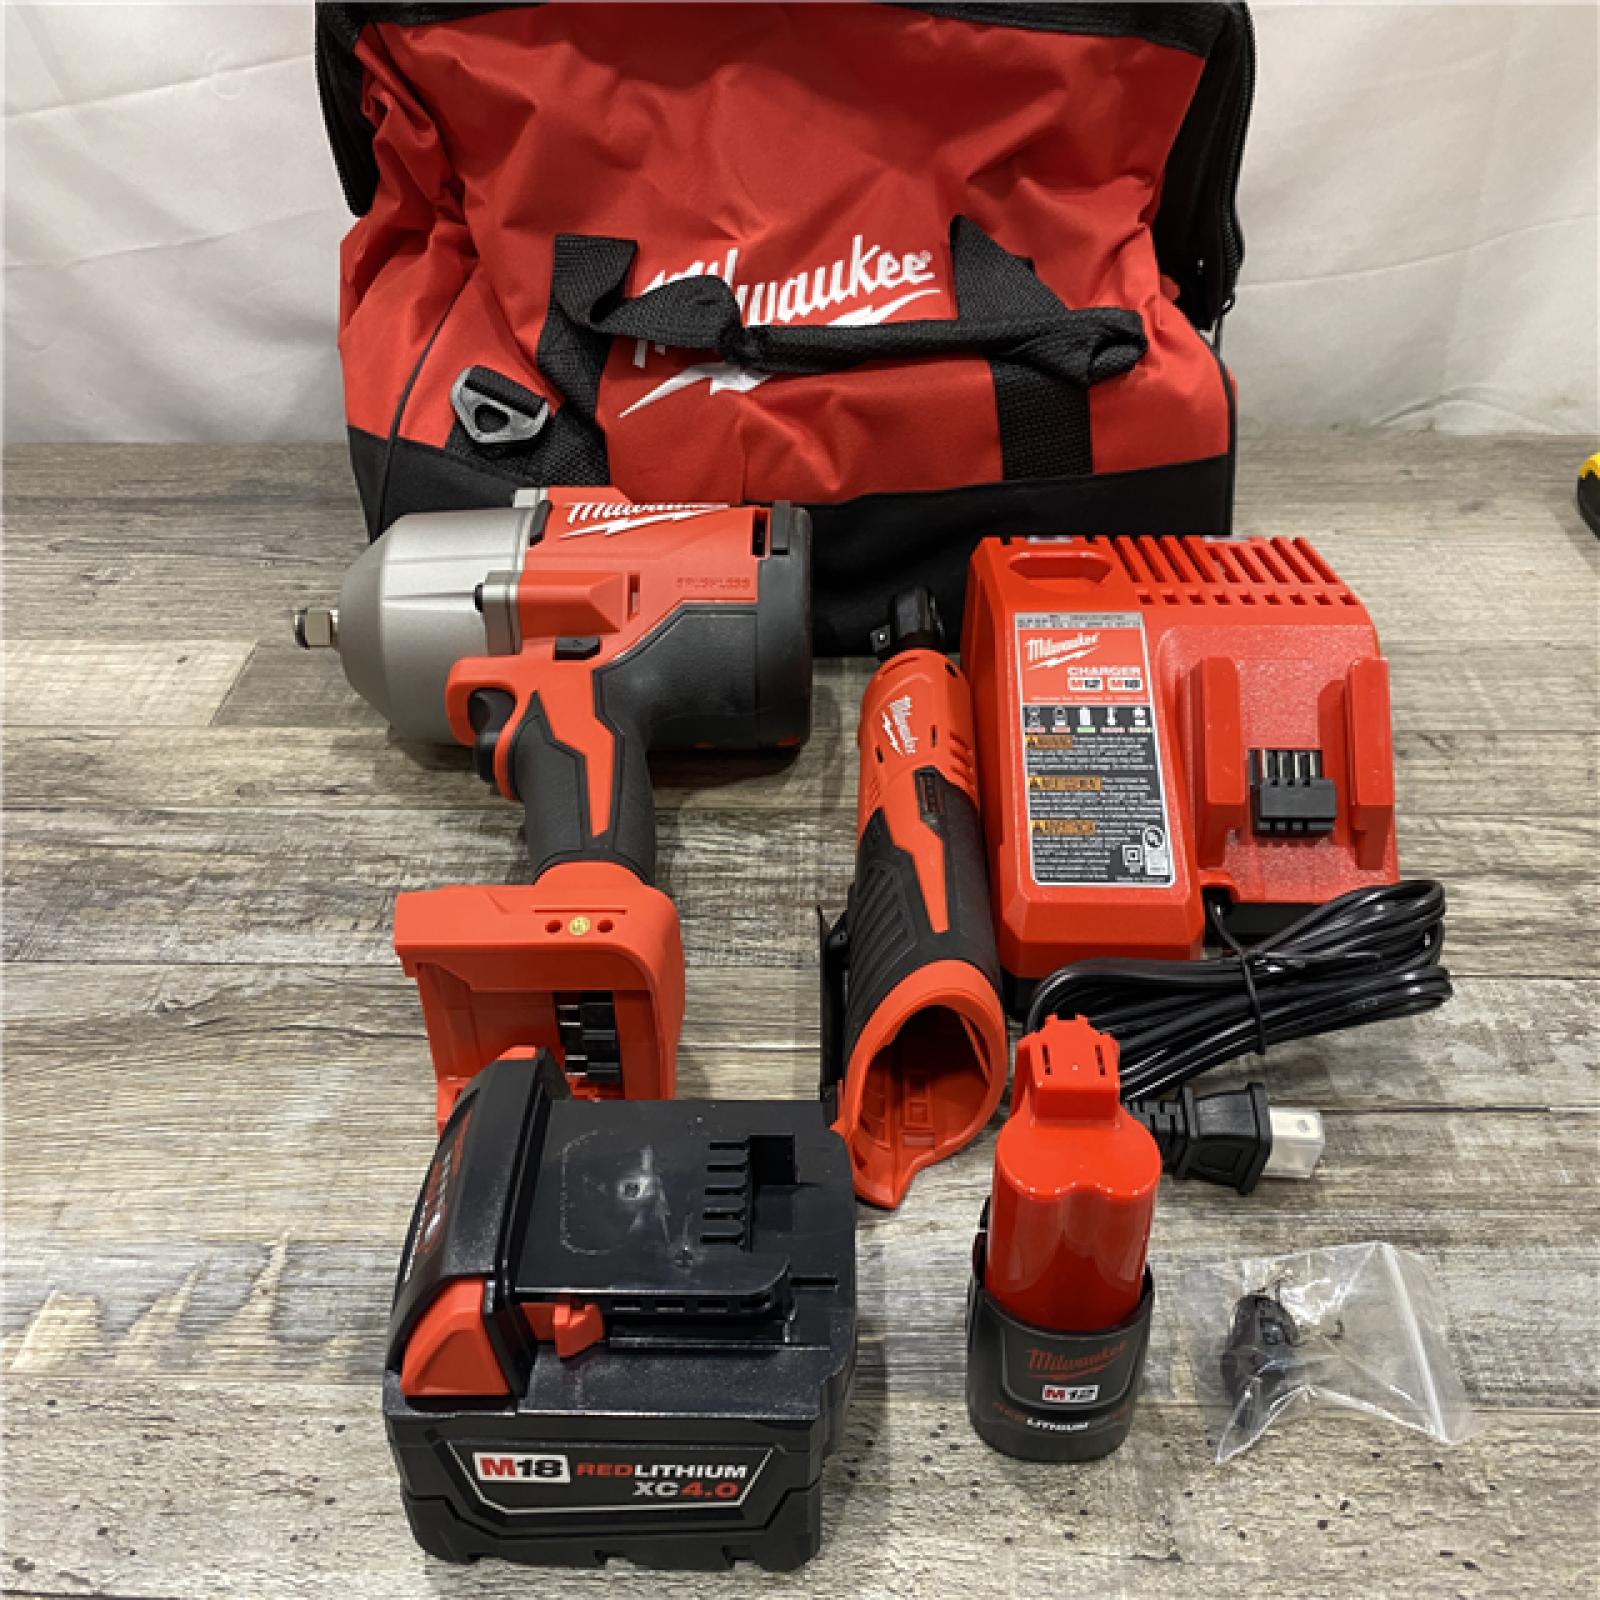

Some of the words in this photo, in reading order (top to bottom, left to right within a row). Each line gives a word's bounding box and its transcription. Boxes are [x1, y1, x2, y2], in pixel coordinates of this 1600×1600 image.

[1066, 666, 1141, 676] CHARGER
[1043, 1386, 1098, 1401] M12
[479, 1456, 564, 1478] M18
[575, 1462, 749, 1479] REDLITHIUM
[631, 1481, 739, 1497] XC4.0
